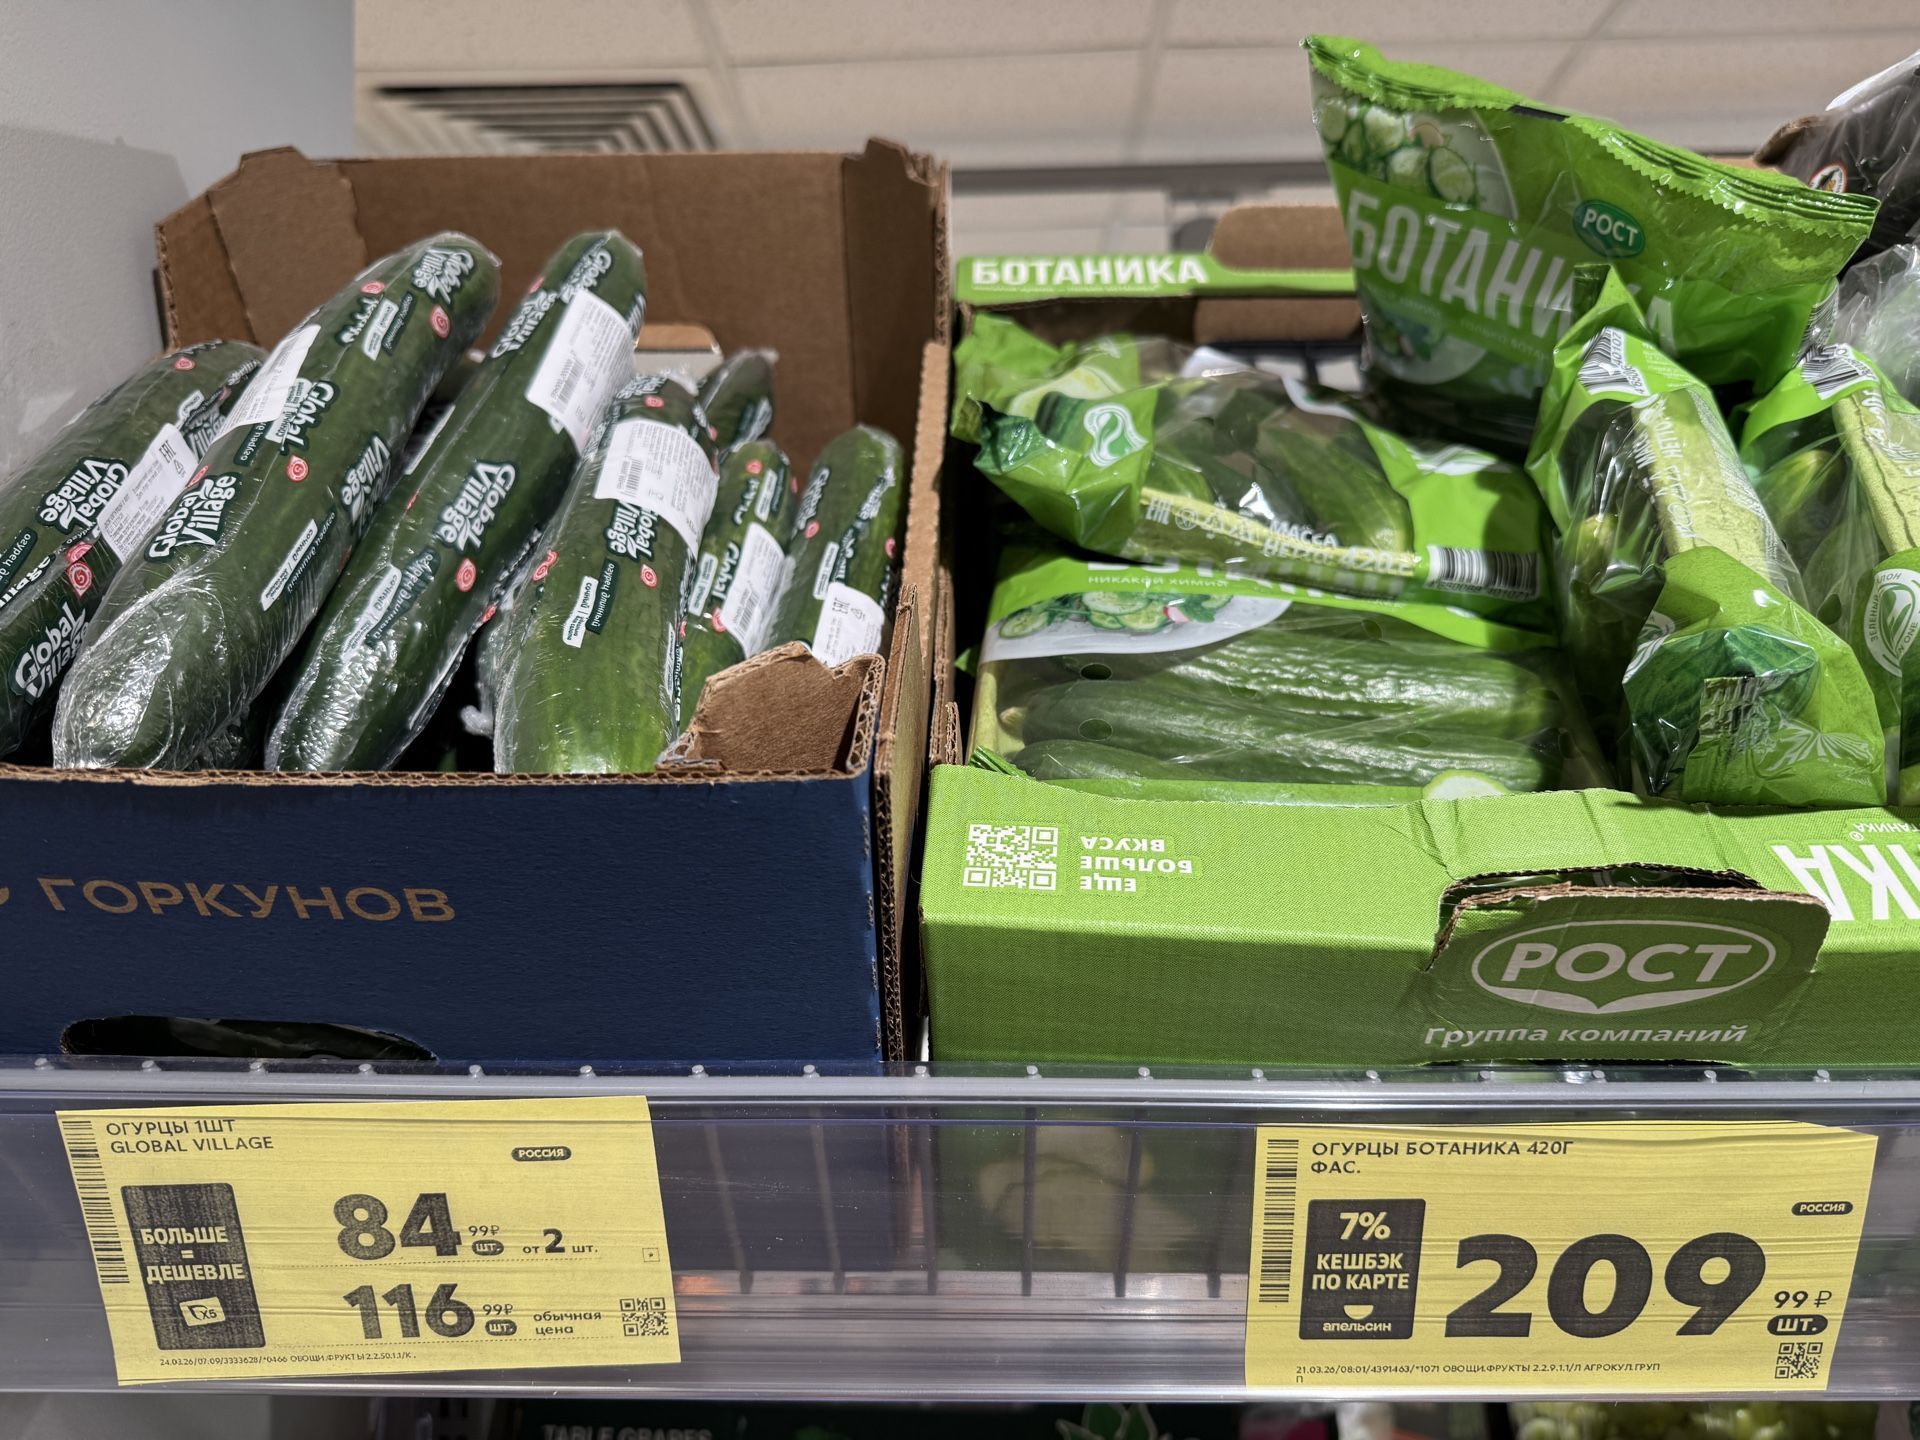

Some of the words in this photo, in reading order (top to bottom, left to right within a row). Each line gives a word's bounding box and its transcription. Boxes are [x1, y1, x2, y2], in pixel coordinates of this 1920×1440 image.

[1581, 208, 1639, 248] РОСТ
[971, 256, 1209, 288] БОТАНИКА
[341, 436, 391, 506] Village
[40, 459, 110, 522] Village
[60, 462, 130, 534] Global
[440, 462, 500, 543] Village
[459, 463, 516, 550] Global
[148, 478, 214, 559] Global
[175, 475, 238, 547] Village
[291, 528, 315, 562] сочный
[314, 511, 337, 547] огурец
[1269, 518, 1339, 548] МАССА
[6, 533, 32, 567] огурец
[287, 543, 317, 594] длинный
[406, 553, 435, 591] огурец
[603, 562, 614, 595] огурец
[580, 582, 592, 609] сочный
[592, 588, 610, 627] длинный
[373, 586, 411, 639] длинный
[15, 602, 86, 689] Global
[1080, 835, 1165, 852] ВКУСА
[1079, 855, 1193, 874] БОЛЬШЕ
[1079, 873, 1137, 892] ЕЩЕ
[37, 876, 456, 923] ГОРКУНОВ
[1500, 943, 1752, 983] РОСТ
[1424, 1027, 1548, 1049] Группа
[1556, 1024, 1748, 1044] компаний
[106, 1120, 189, 1137] ОГУРЦЫ
[194, 1119, 236, 1134] 1ШТ
[110, 1138, 188, 1154] GLOBAL
[193, 1136, 274, 1151] VILLAGE
[518, 1148, 566, 1159] РОССИЯ
[1312, 1142, 1399, 1157] ОГУРЦЫ
[1406, 1141, 1521, 1155] БОТАНИКА
[1526, 1140, 1574, 1155] 420Г
[1310, 1160, 1361, 1175] ФАС.
[1799, 1203, 1846, 1213] РОССИЯ
[140, 1226, 229, 1245] БОЛЬШЕ
[333, 1192, 463, 1260] 84
[522, 1246, 540, 1254] от
[543, 1228, 566, 1254] 2
[1339, 1211, 1391, 1240] 7%
[146, 1263, 247, 1284] ДЕШЕВЛЕ
[1316, 1253, 1403, 1270] КЕШБЭК
[1312, 1273, 1341, 1290] ПО
[1346, 1273, 1410, 1290] КАРТЕ
[1444, 1232, 1767, 1339] 209
[343, 1283, 475, 1339] 116
[533, 1311, 602, 1322] обычная
[1323, 1321, 1392, 1332] апельсин
[535, 1325, 574, 1336] цена
